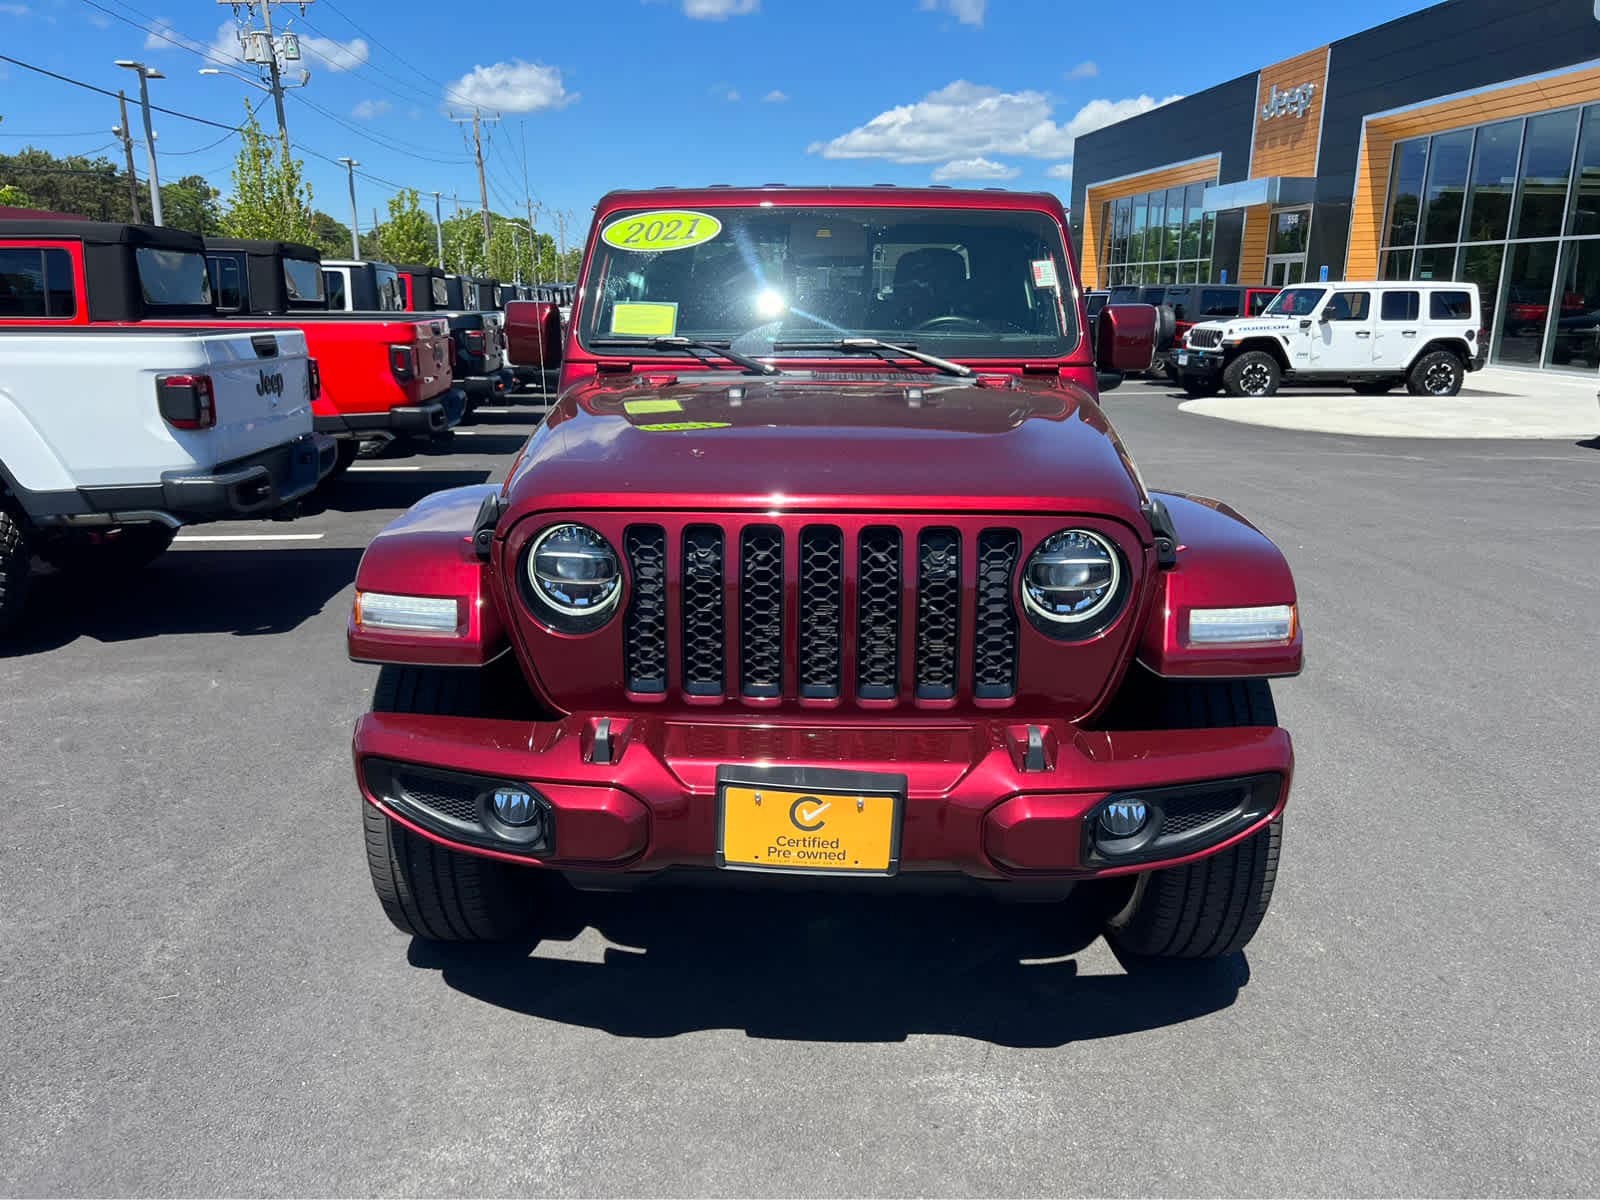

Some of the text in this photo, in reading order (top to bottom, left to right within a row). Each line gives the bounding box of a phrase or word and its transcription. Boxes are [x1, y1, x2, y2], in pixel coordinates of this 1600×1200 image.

[1262, 83, 1314, 120] Jeep
[623, 218, 701, 244] 2021
[256, 369, 284, 398] Jeep
[776, 835, 840, 850] Certified
